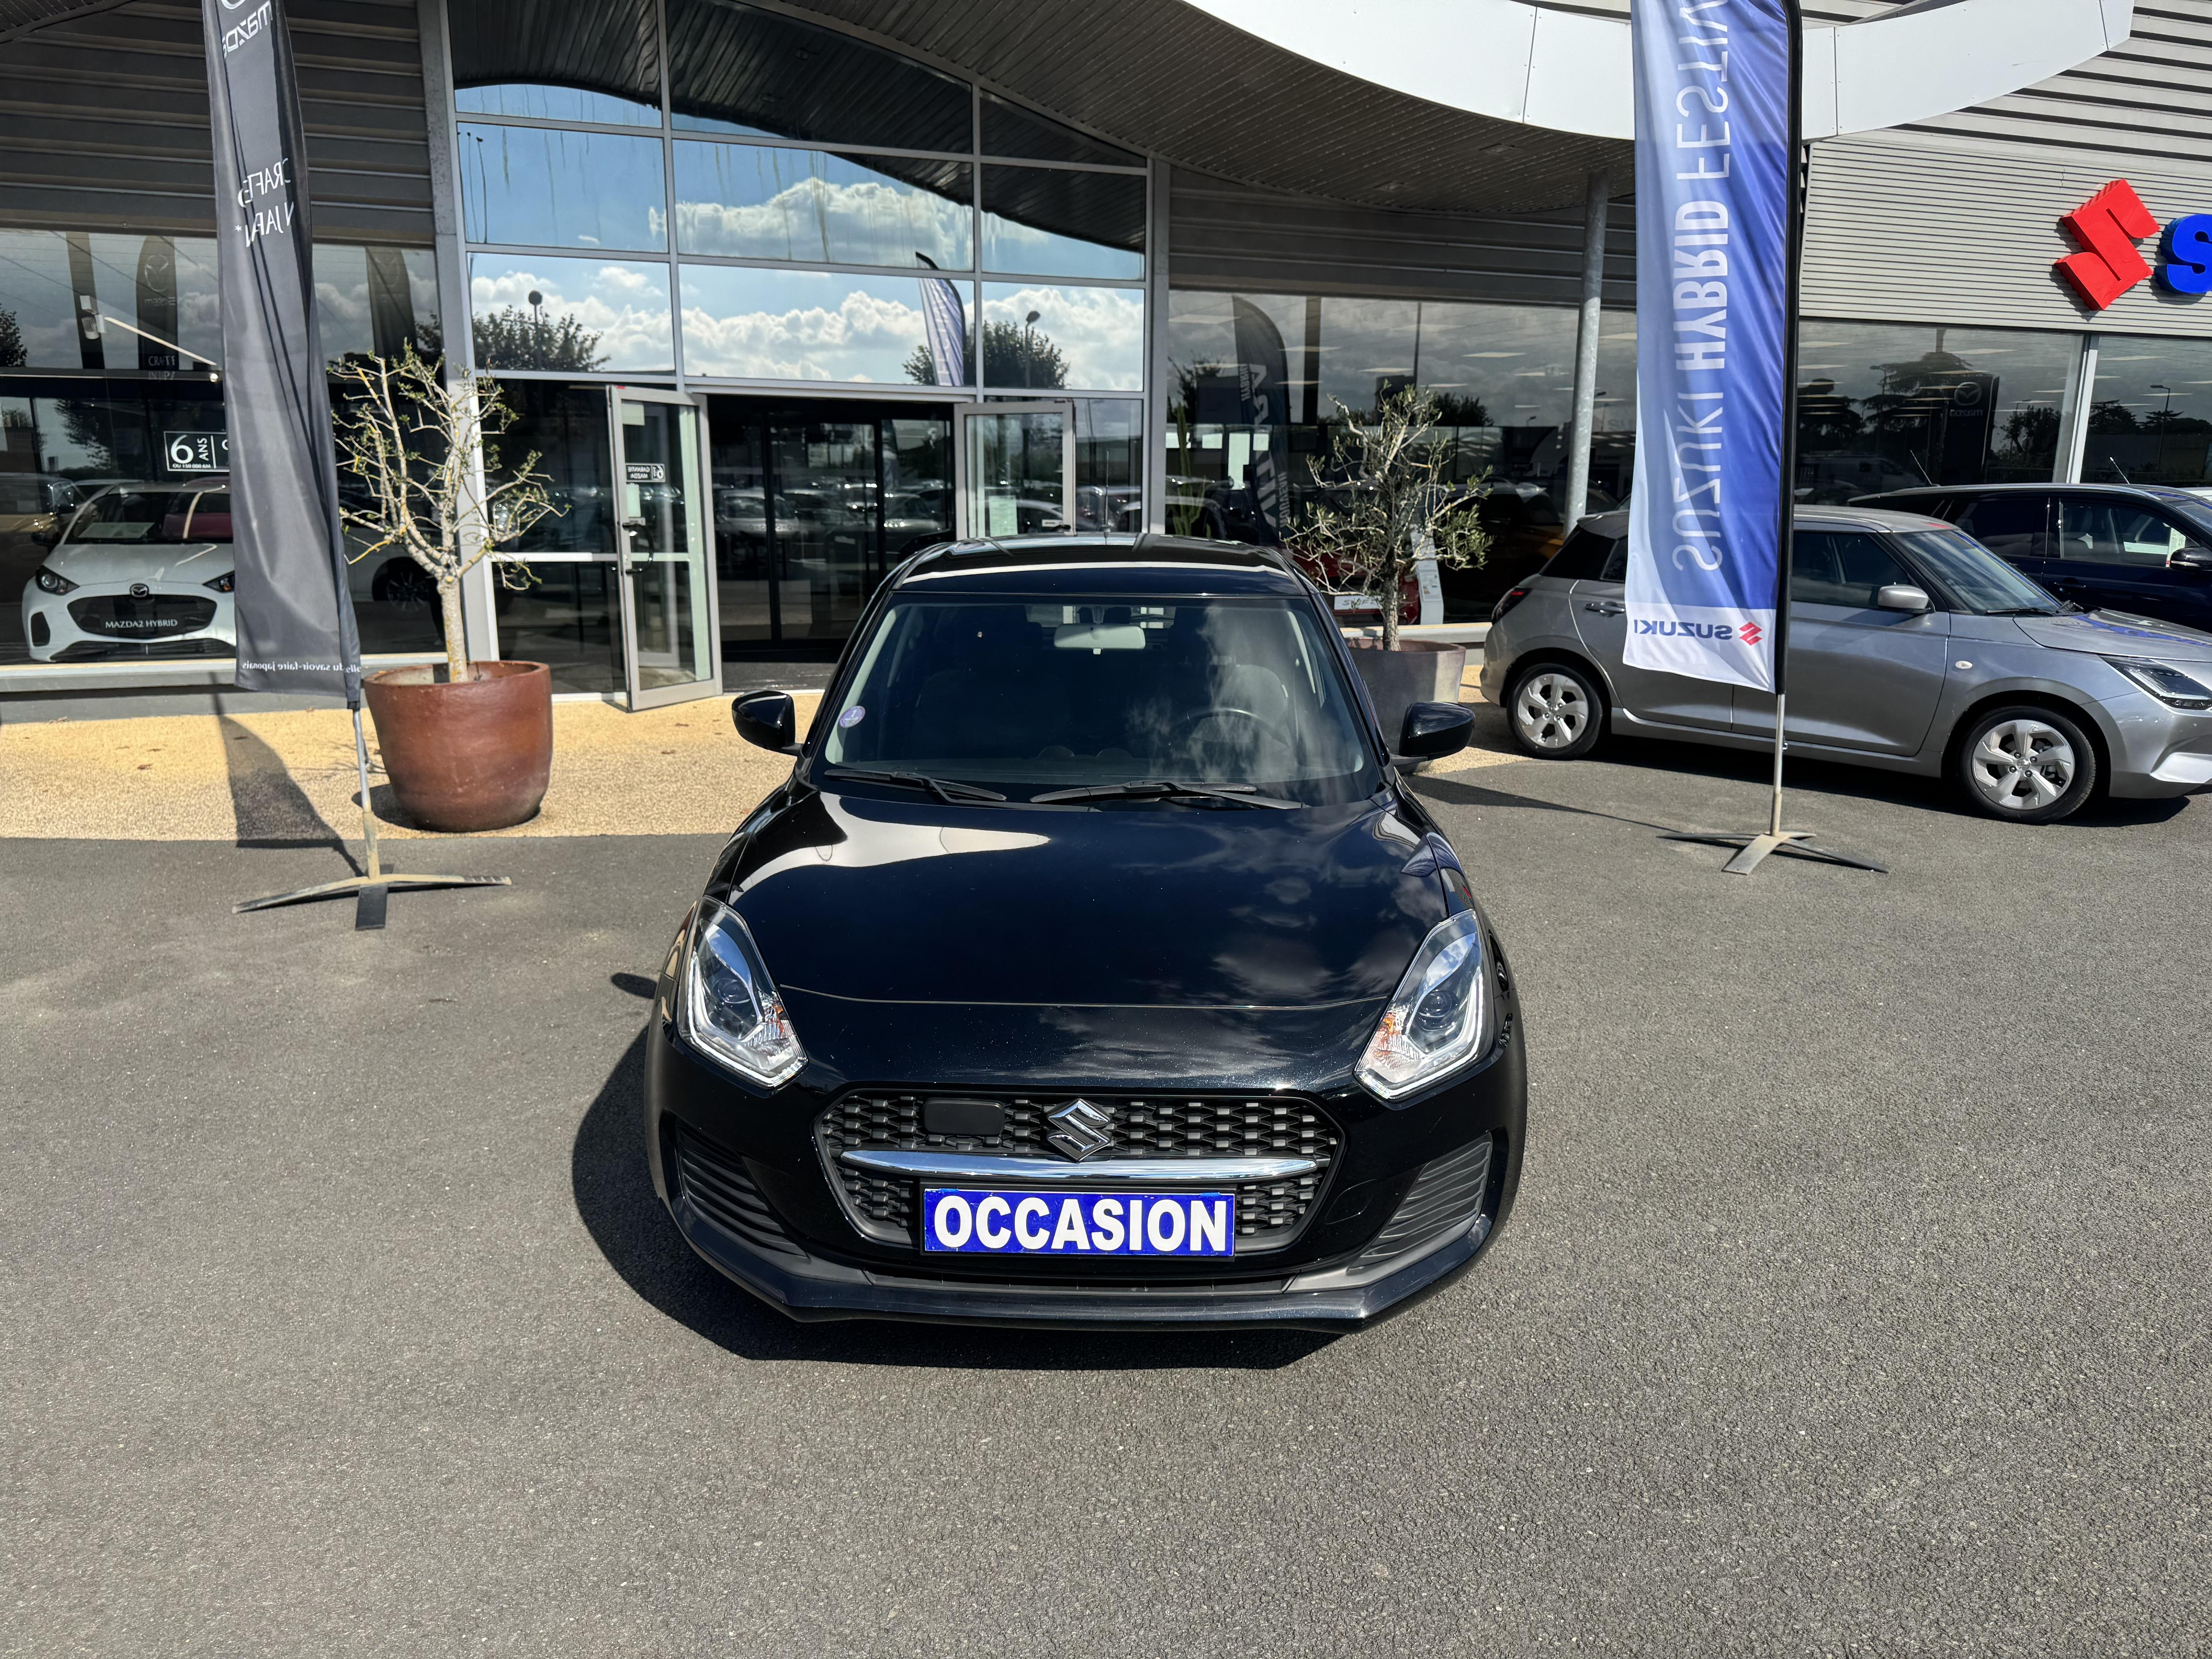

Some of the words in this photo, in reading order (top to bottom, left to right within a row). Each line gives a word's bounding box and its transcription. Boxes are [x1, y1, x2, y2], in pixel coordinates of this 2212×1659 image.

[171, 434, 194, 464] 6
[197, 438, 210, 461] ANS
[105, 620, 144, 629] MAZDA2
[146, 618, 178, 627] HYBRID
[934, 1195, 1227, 1252] OCCASION
